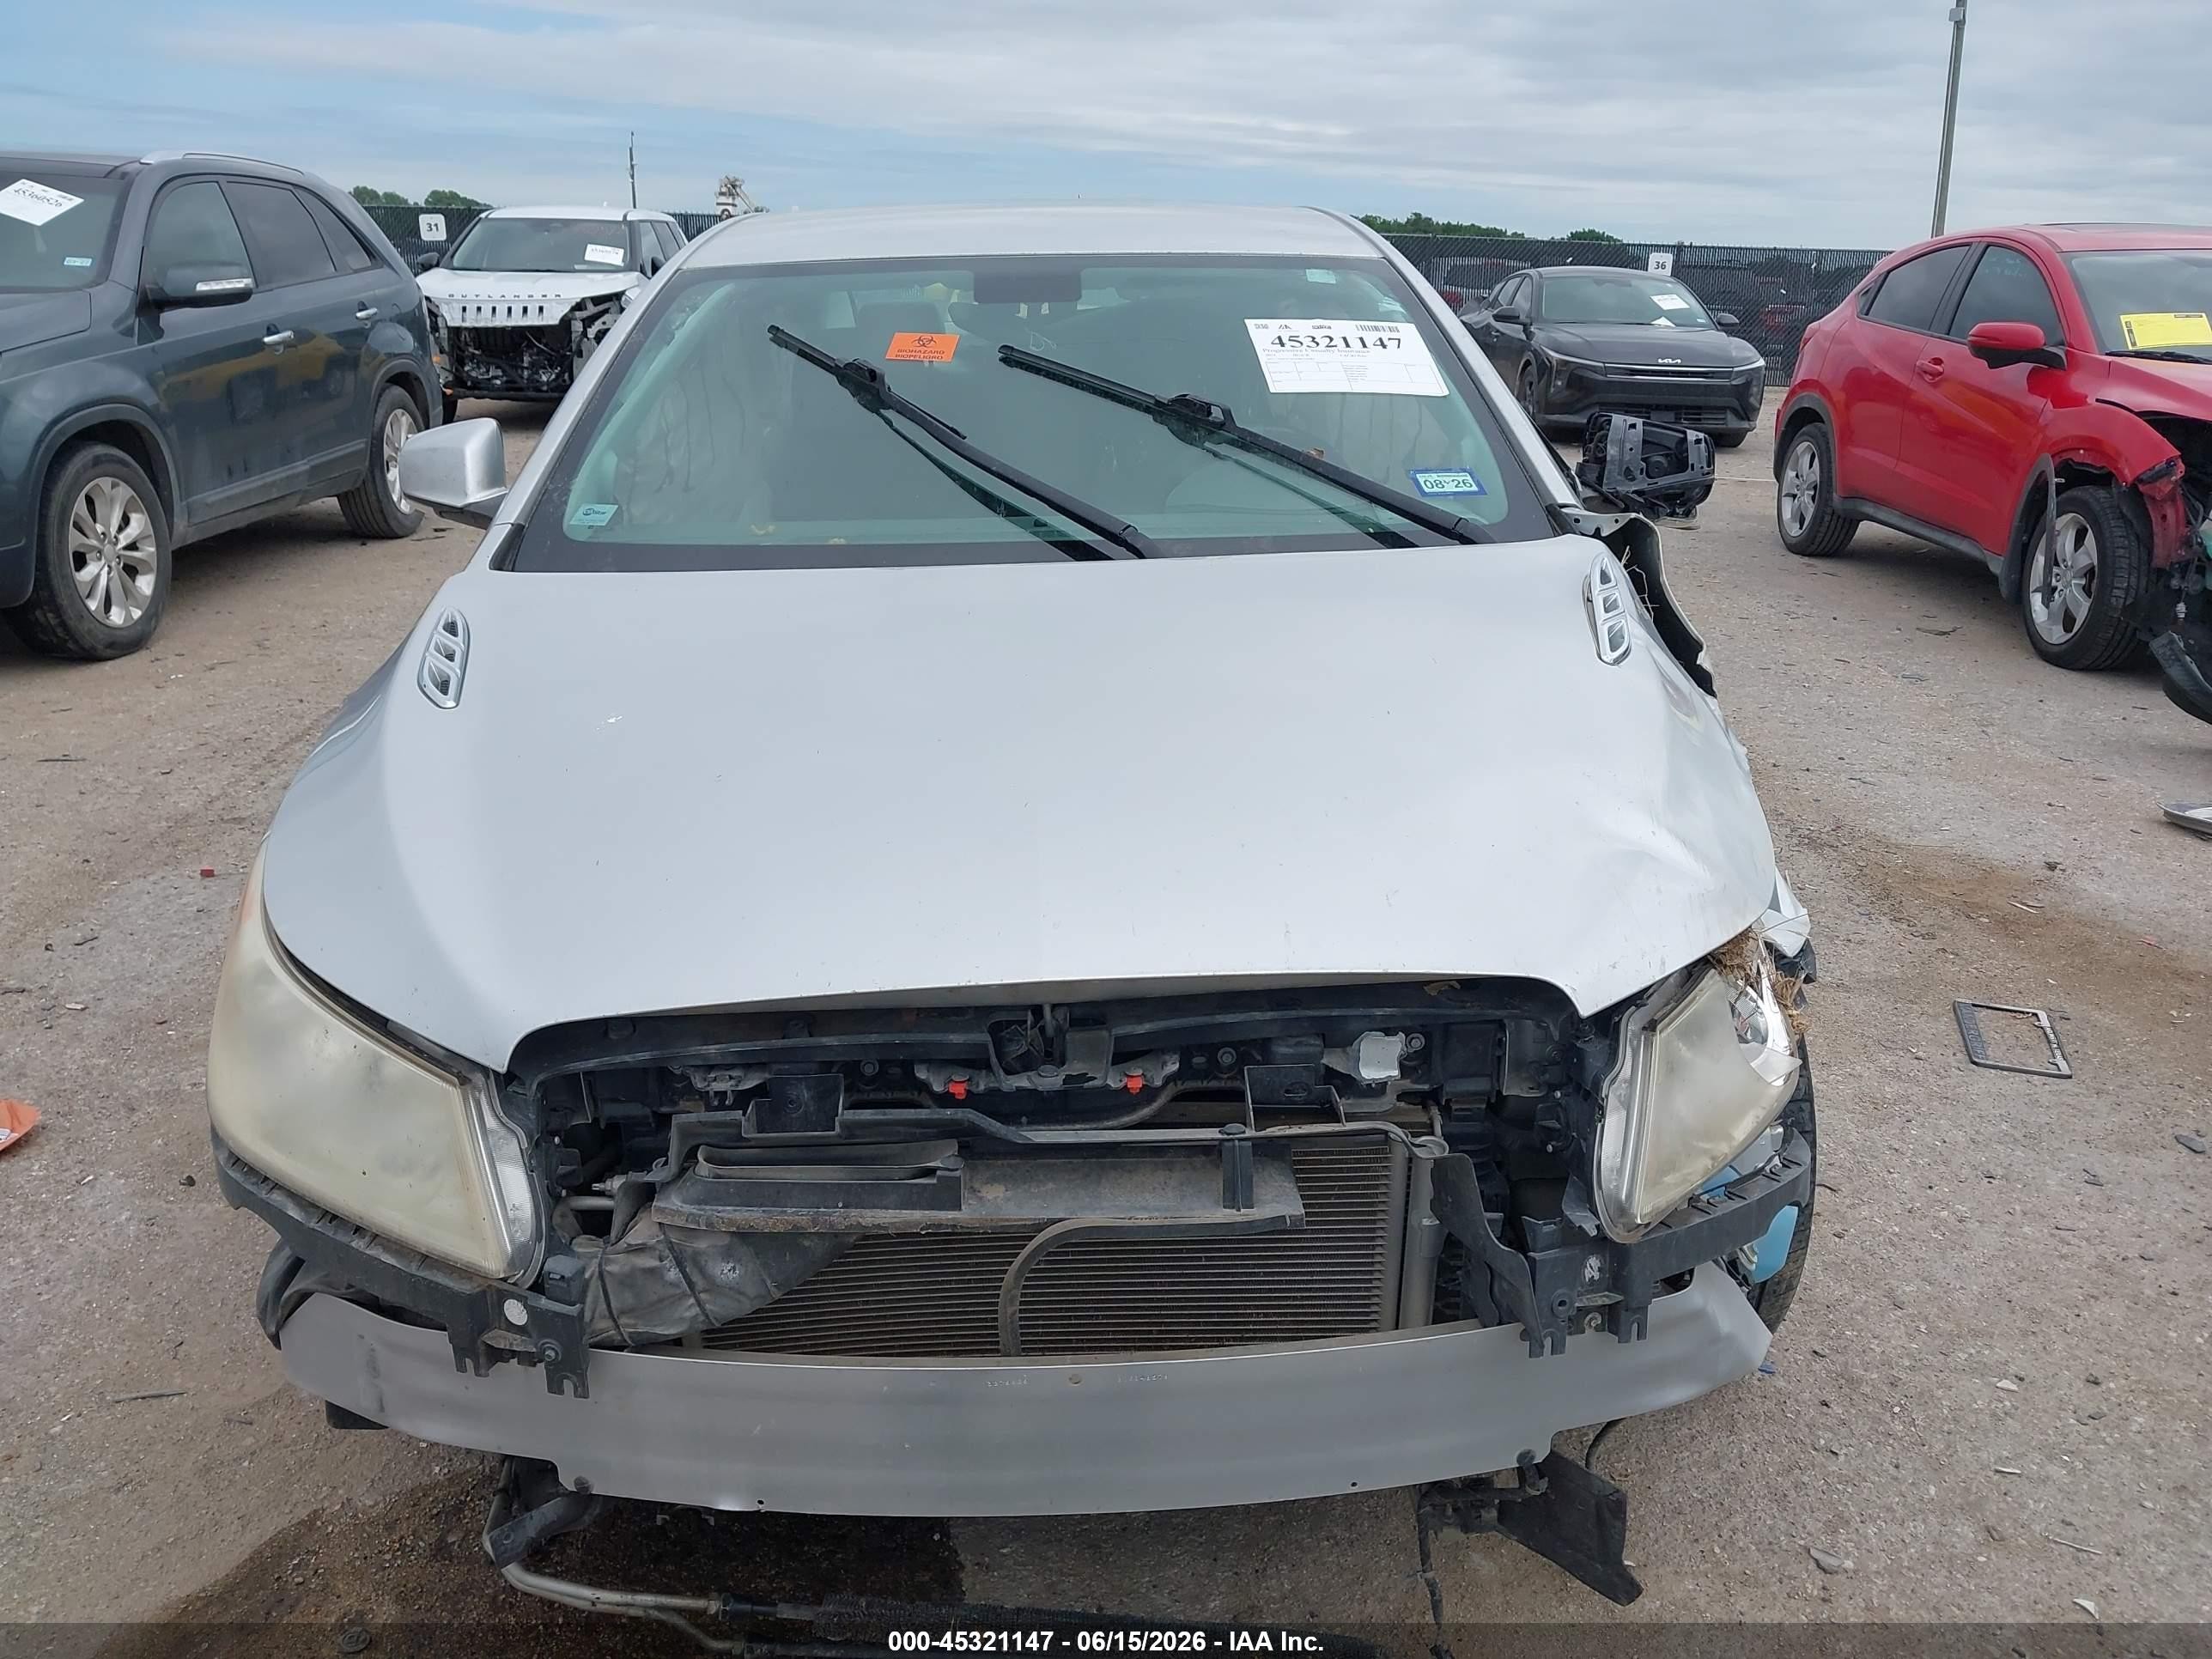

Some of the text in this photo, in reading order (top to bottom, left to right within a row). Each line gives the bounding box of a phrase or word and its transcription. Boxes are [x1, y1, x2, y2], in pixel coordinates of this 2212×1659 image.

[426, 222, 439, 232] 31
[1654, 261, 1668, 270] 36
[1270, 335, 1401, 349] 45321147
